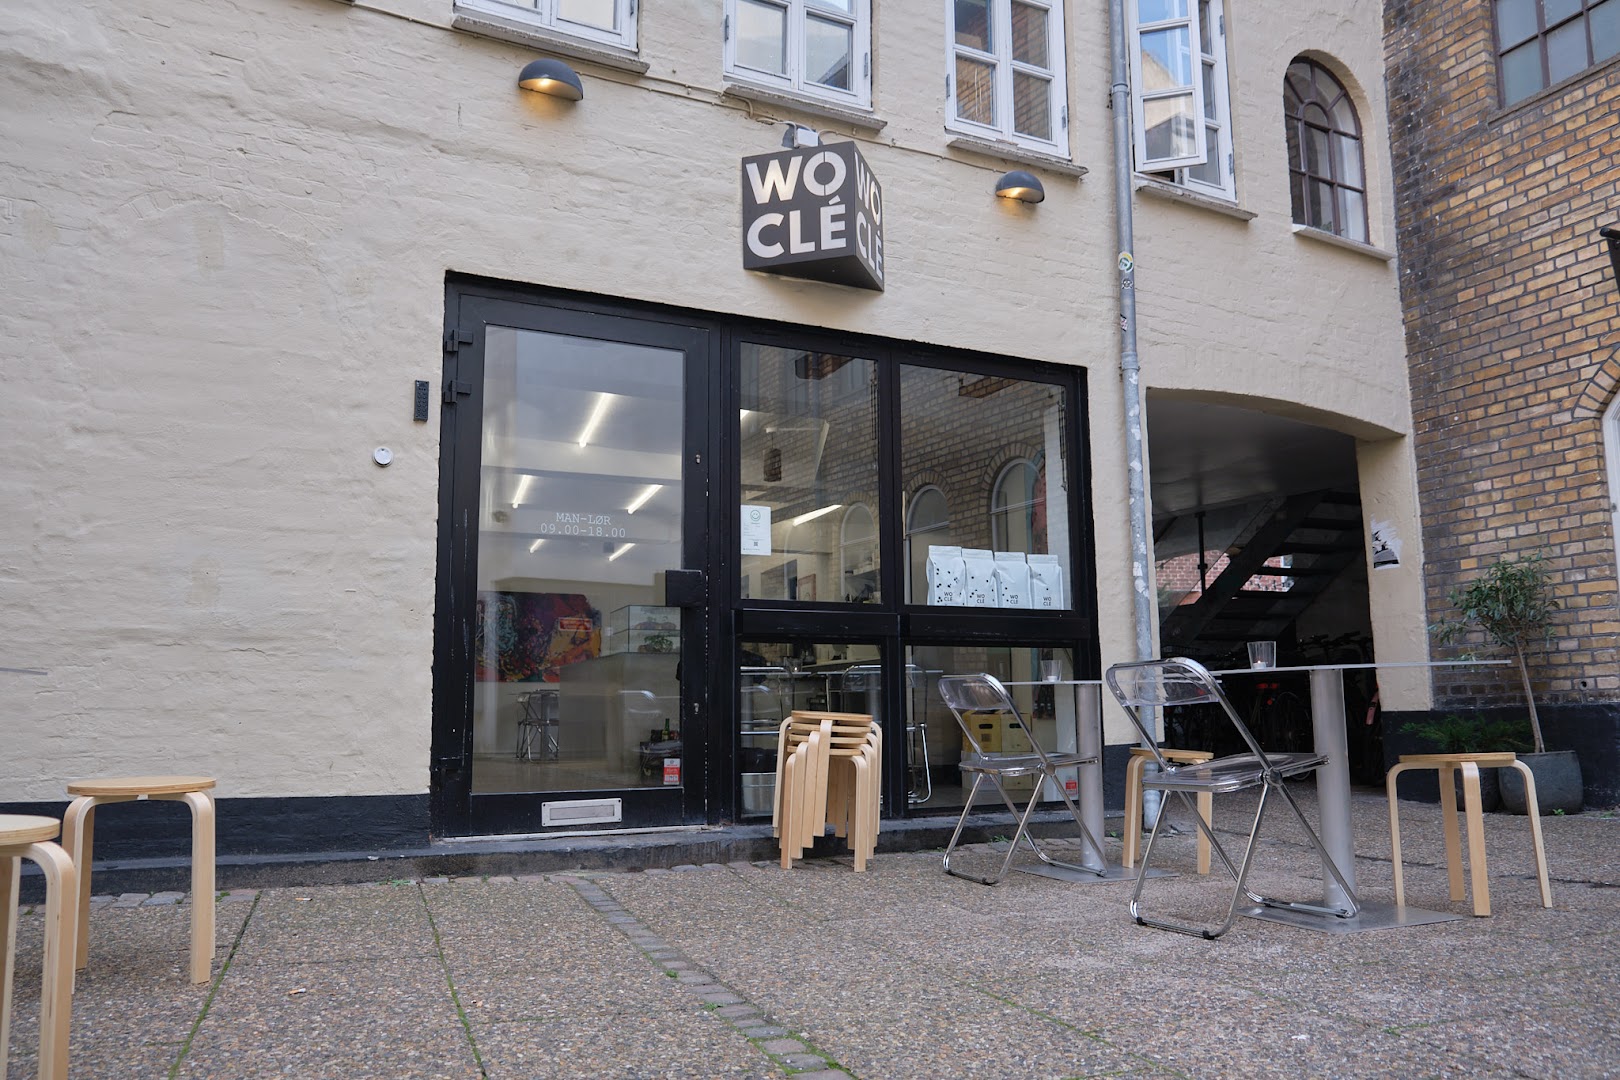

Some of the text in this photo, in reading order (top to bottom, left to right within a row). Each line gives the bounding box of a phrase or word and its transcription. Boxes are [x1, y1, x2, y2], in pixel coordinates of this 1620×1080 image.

[745, 151, 847, 205] WO
[854, 151, 881, 226] WO
[746, 195, 847, 259] CLÉ
[856, 211, 883, 280] CLÉ
[540, 522, 626, 538] 09.00-18.00
[556, 512, 612, 526] MAN-LØR
